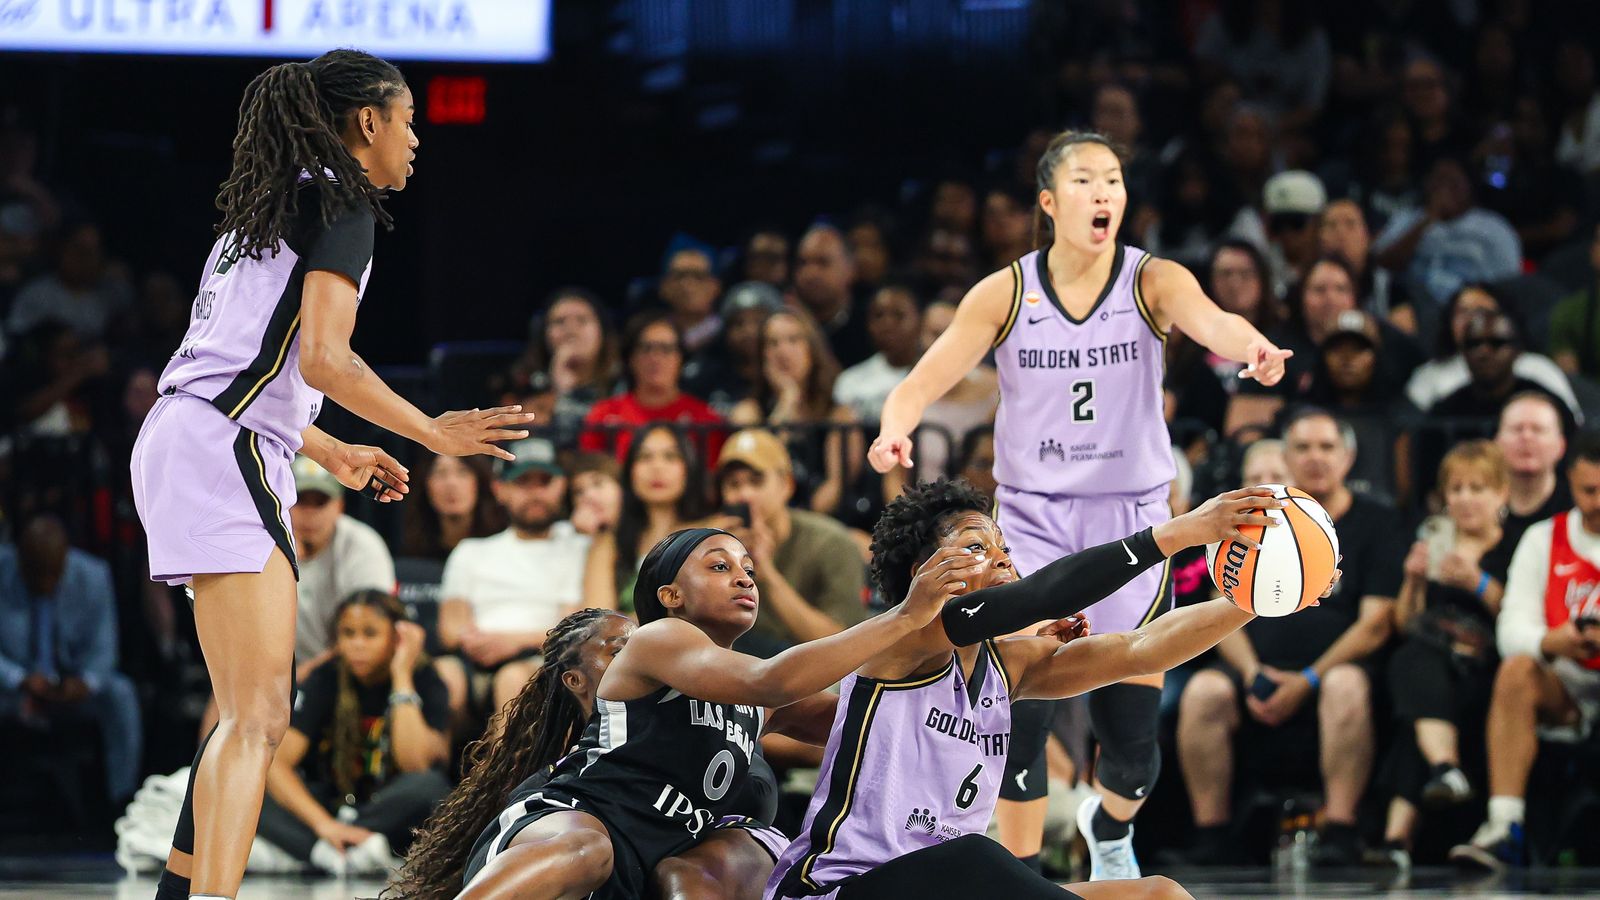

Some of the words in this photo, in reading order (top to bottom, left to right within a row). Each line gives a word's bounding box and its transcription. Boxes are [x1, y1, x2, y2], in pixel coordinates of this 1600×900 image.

[1018, 348, 1081, 369] GOLDEN
[1087, 340, 1139, 368] STATE
[1071, 380, 1096, 423] 2
[689, 699, 725, 731] LAS
[725, 719, 755, 766] EGAS
[924, 706, 977, 746] GOLDE
[703, 749, 736, 802] 0
[955, 762, 984, 811] 6
[652, 783, 715, 840] IPS
